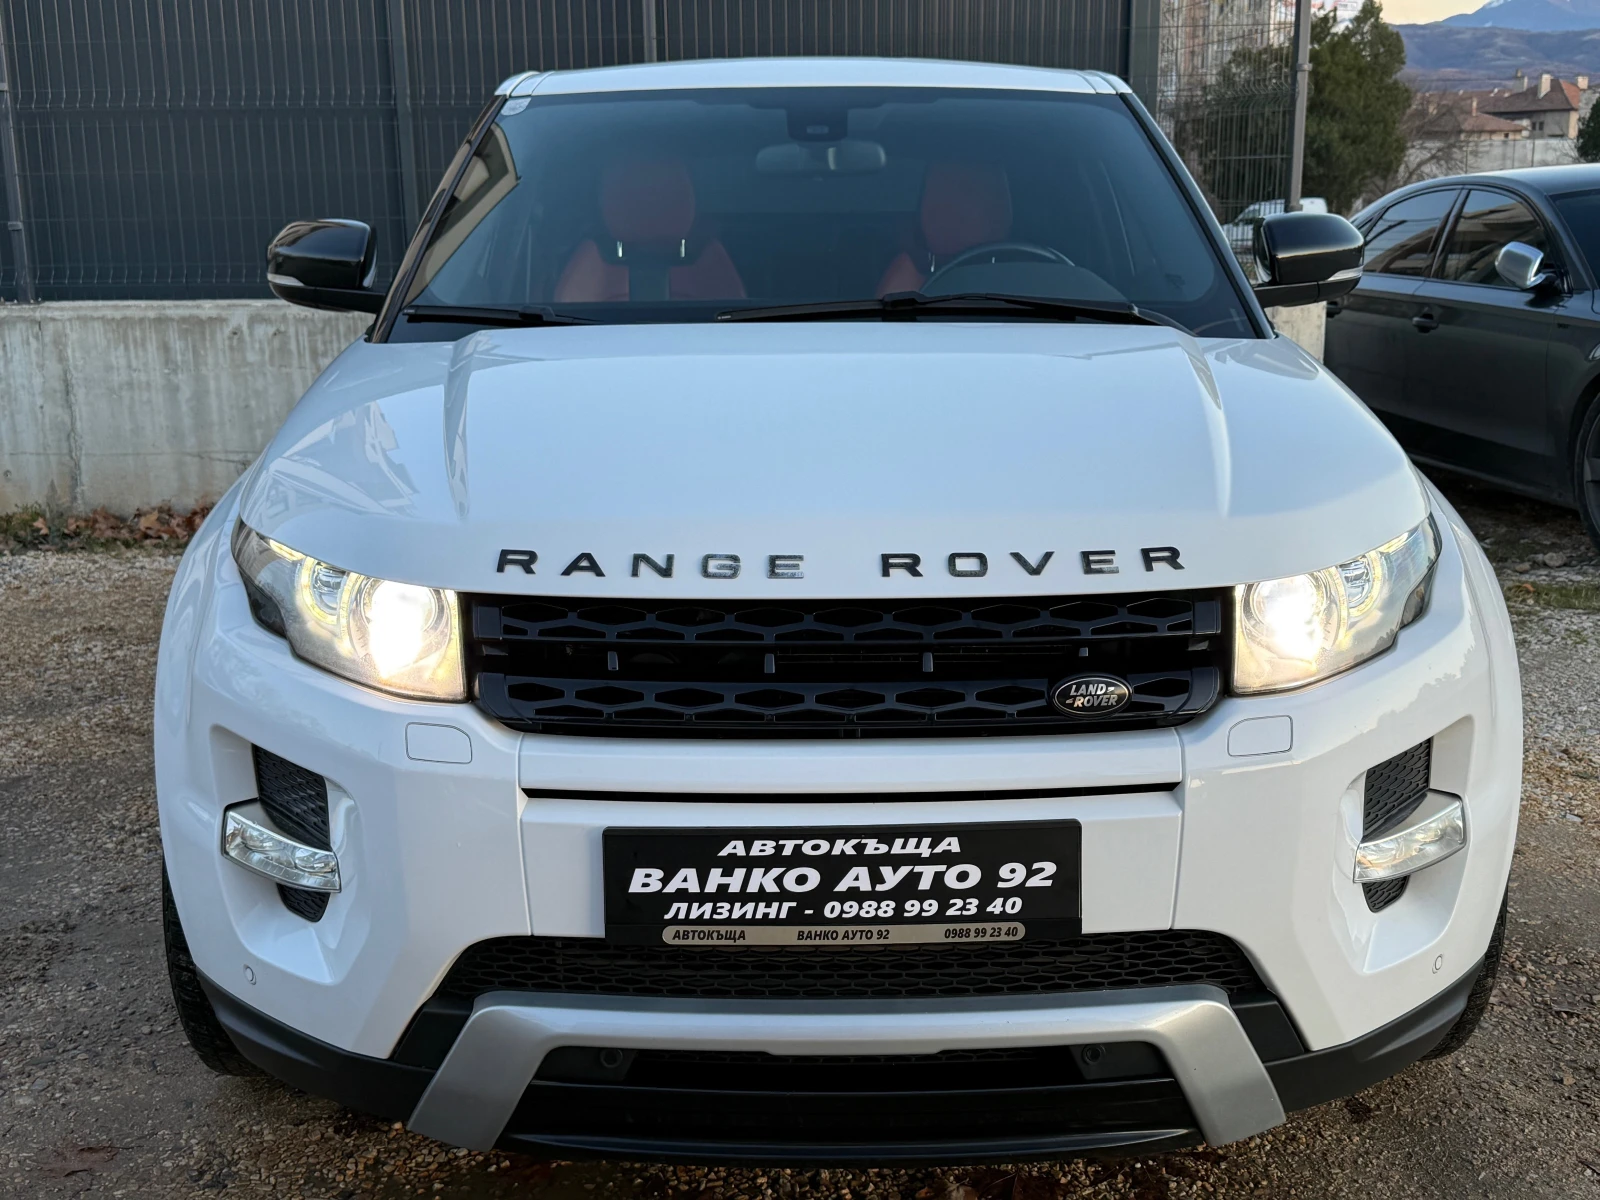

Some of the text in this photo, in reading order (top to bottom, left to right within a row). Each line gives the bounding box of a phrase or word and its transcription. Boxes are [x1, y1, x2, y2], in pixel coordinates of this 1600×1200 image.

[496, 545, 1186, 580] RANGE ROVER
[1070, 683, 1118, 708] LAND ROVER
[718, 836, 961, 857] АВТОКЪЩА
[628, 861, 1057, 893] ВАНКО АУТО 92
[663, 902, 797, 920] ЛИЗИНГ
[823, 900, 896, 919] 0988
[904, 899, 939, 917] 99
[946, 897, 979, 916] 23
[986, 896, 1023, 915] 40
[672, 926, 1019, 944] АВТОКЪЩА ВАНКО АУТО 92 0988 99 23 40
